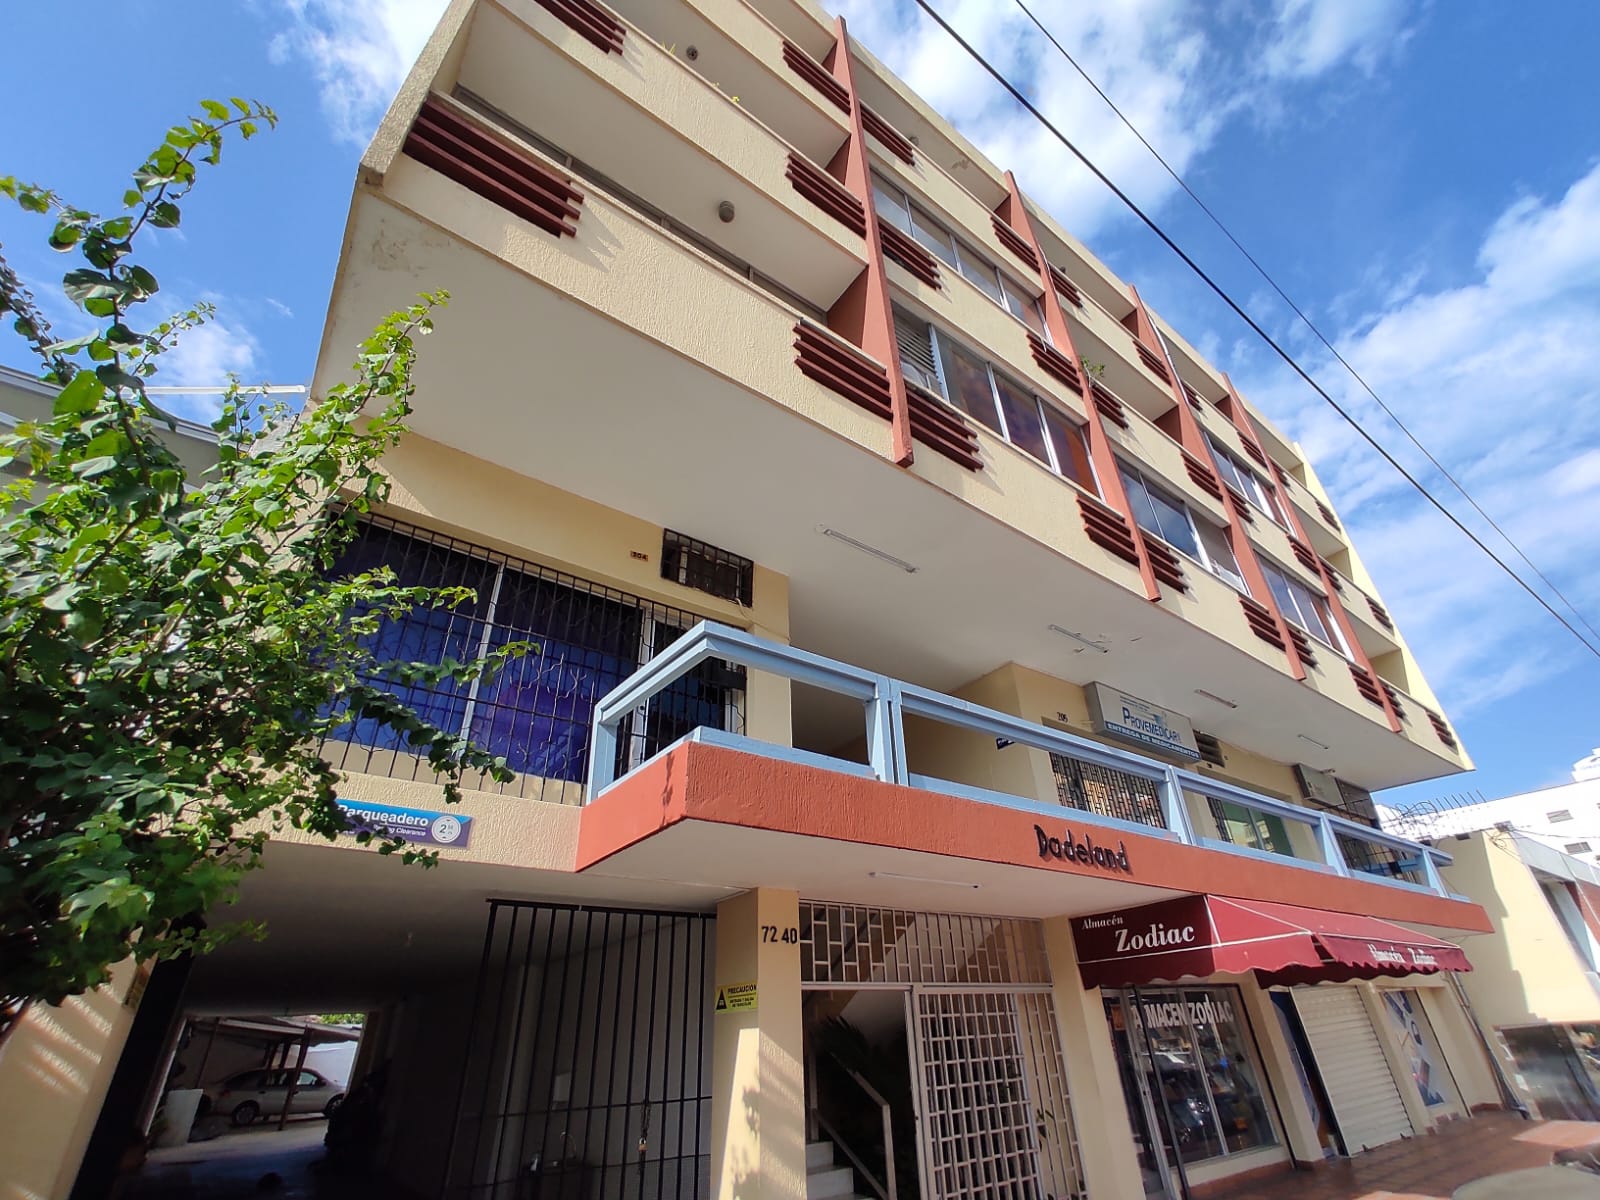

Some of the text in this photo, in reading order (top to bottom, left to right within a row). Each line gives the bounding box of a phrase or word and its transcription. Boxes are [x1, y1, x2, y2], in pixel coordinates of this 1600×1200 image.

[1034, 824, 1130, 871] Dadeland
[761, 926, 798, 944] 72 40
[1082, 915, 1124, 930] Almacén
[1115, 924, 1195, 952] Zodiac
[1130, 1000, 1234, 1030] AMACEN ZODIAC
